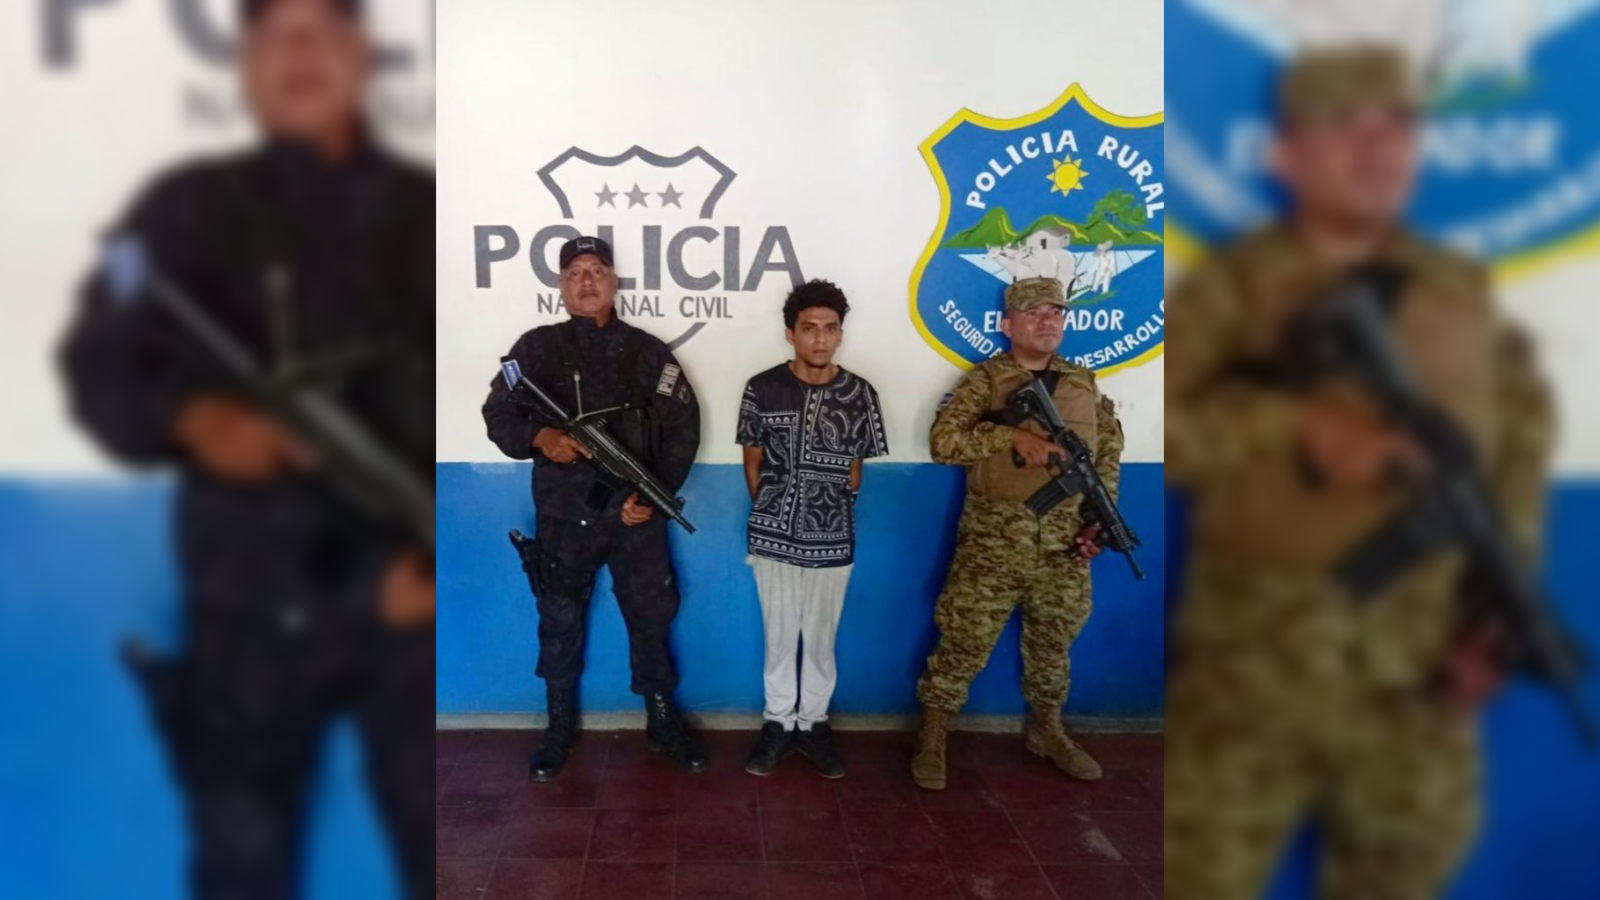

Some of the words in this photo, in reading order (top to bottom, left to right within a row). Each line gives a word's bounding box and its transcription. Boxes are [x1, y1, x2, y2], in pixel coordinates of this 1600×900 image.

[965, 130, 1078, 209] POLICIA
[1097, 135, 1164, 219] RURAL
[679, 296, 733, 319] CIVIL
